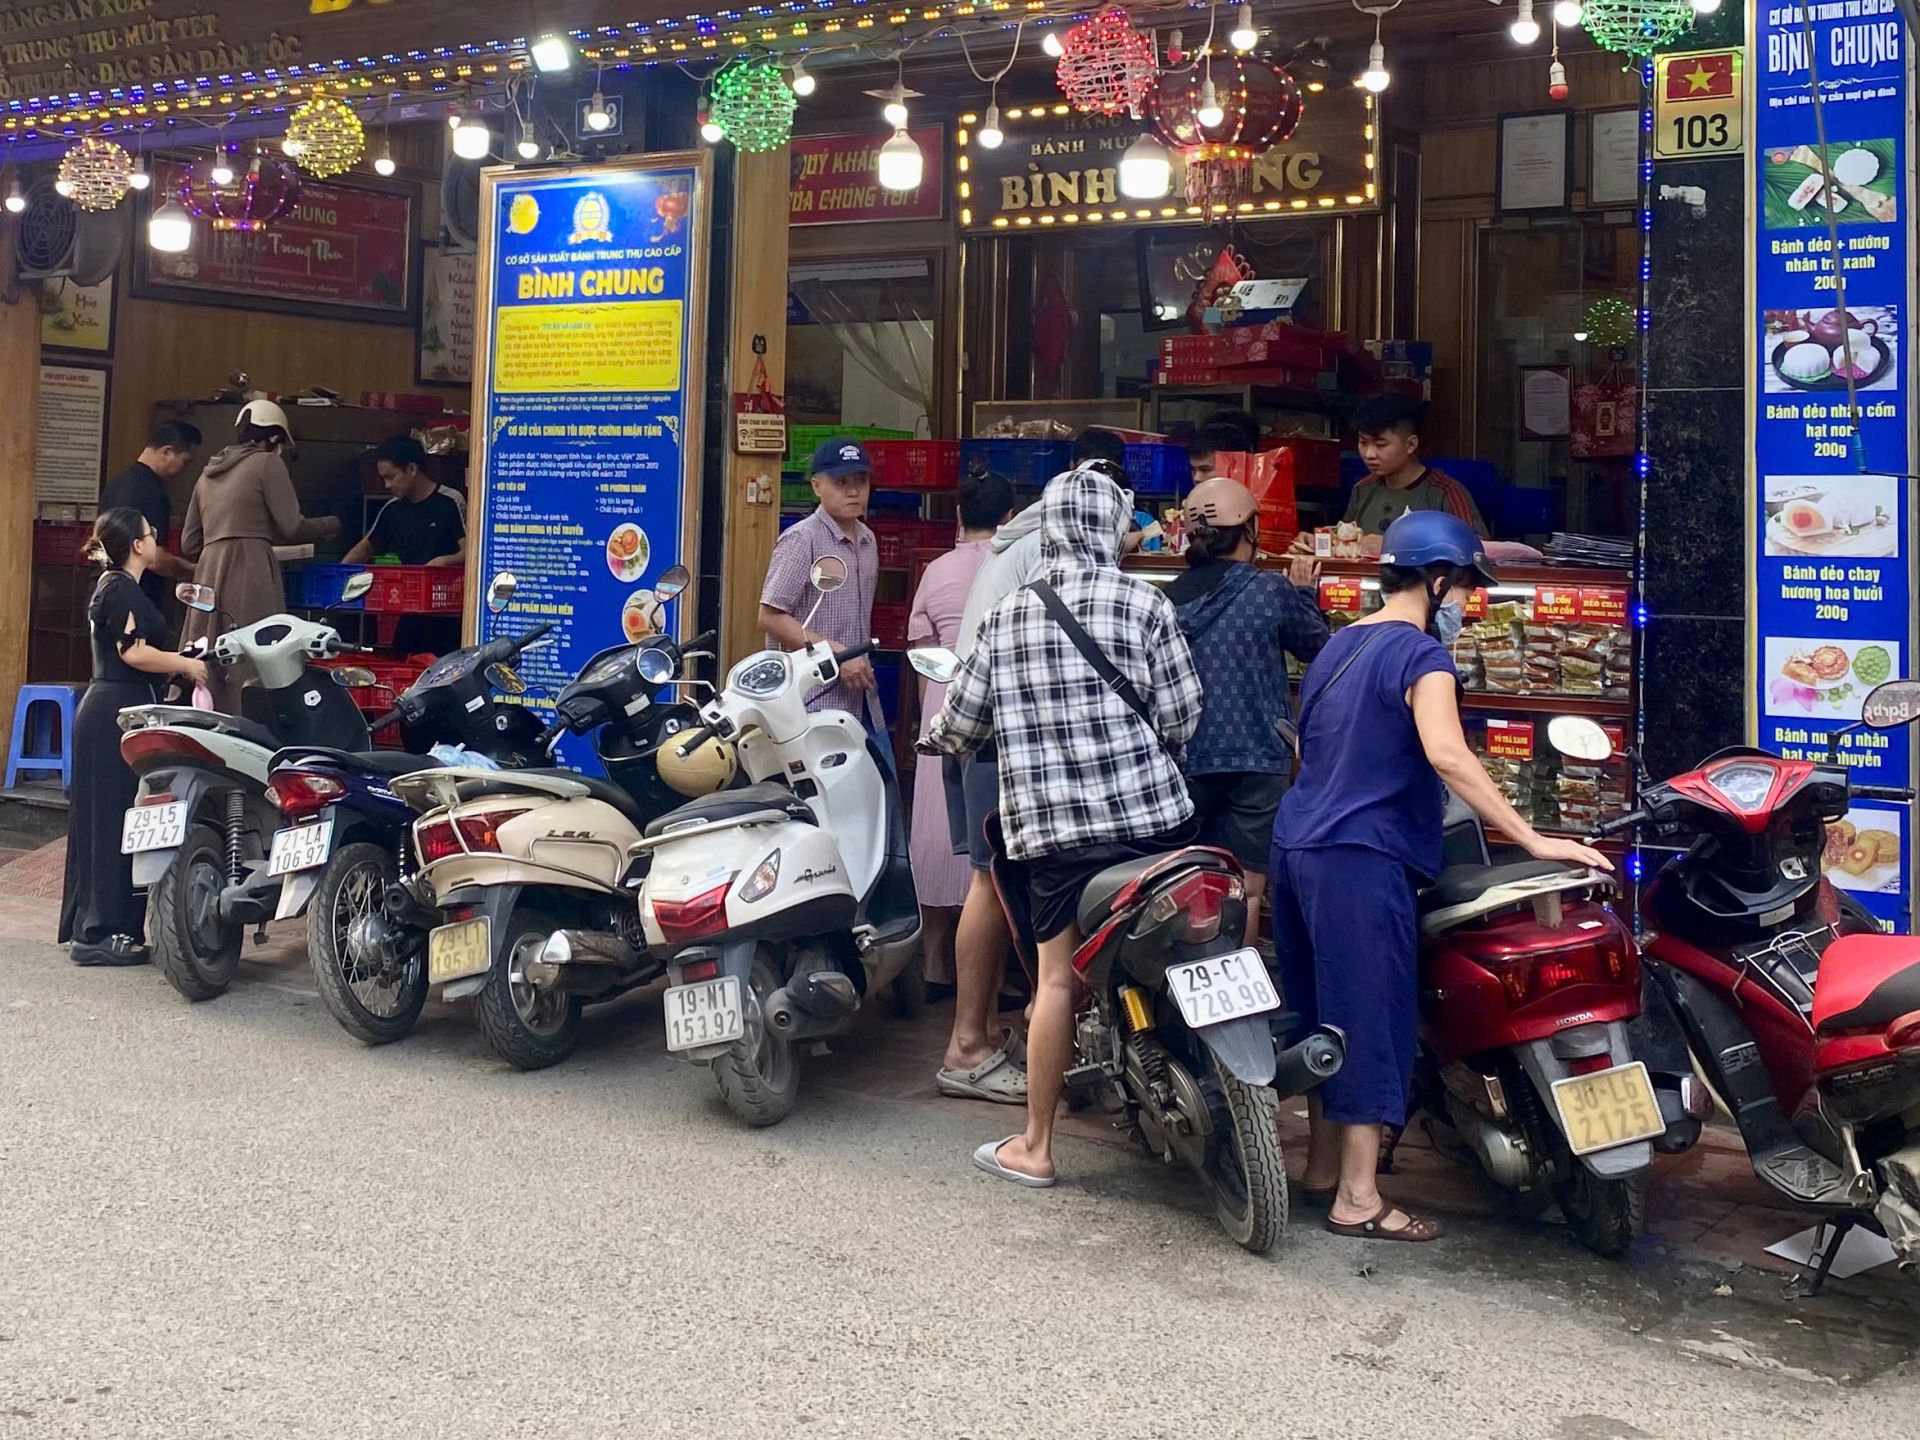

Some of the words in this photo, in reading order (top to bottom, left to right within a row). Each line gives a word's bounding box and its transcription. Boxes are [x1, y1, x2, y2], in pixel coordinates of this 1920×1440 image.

[2, 37, 72, 65] TRUNG
[201, 41, 250, 72] DÂN
[1831, 22, 1899, 68] CHUNG
[1673, 113, 1728, 149] 103
[1031, 137, 1085, 156] BÁNH
[819, 184, 877, 211] CHÚNG
[1001, 162, 1117, 210] BÌNH
[571, 250, 595, 262] BÁNH
[596, 249, 624, 261] TRUNG
[626, 248, 643, 259] THU
[644, 247, 663, 257] CAO
[1771, 239, 1804, 254] Bánh
[1807, 236, 1832, 252] dẻo
[1849, 234, 1890, 250] nướng
[1785, 257, 1817, 273] nhân
[1843, 254, 1875, 270] xanh
[518, 266, 575, 299] BÌNH
[580, 267, 665, 297] CHUNG
[1767, 404, 1799, 419] Bánh
[1803, 402, 1827, 419] dẻo
[1867, 400, 1896, 418] cốm
[1806, 424, 1827, 440] hạt
[1814, 442, 1847, 458] 200g
[1783, 565, 1816, 580] Bánh
[1820, 564, 1844, 580] dẻo
[1848, 567, 1880, 583] chay
[1781, 584, 1821, 601] hương
[1825, 585, 1850, 600] hoa
[1853, 584, 1883, 601] bưởi
[1815, 604, 1848, 621] 200g
[1775, 728, 1808, 743] Bánh
[1855, 732, 1889, 748] nhân
[133, 805, 176, 829] 29-L5
[127, 826, 180, 850] 577.47
[281, 827, 322, 851] 21-LA
[440, 923, 480, 953] 29-L1
[1182, 956, 1250, 992] 29-C1
[678, 982, 727, 1016] 19-N1
[1185, 980, 1271, 1022] 728.98
[672, 1009, 738, 1045] 153.92
[1555, 1012, 1595, 1026] HONDA
[1568, 1072, 1639, 1113] 30-L6
[1579, 1103, 1649, 1147] 2125
